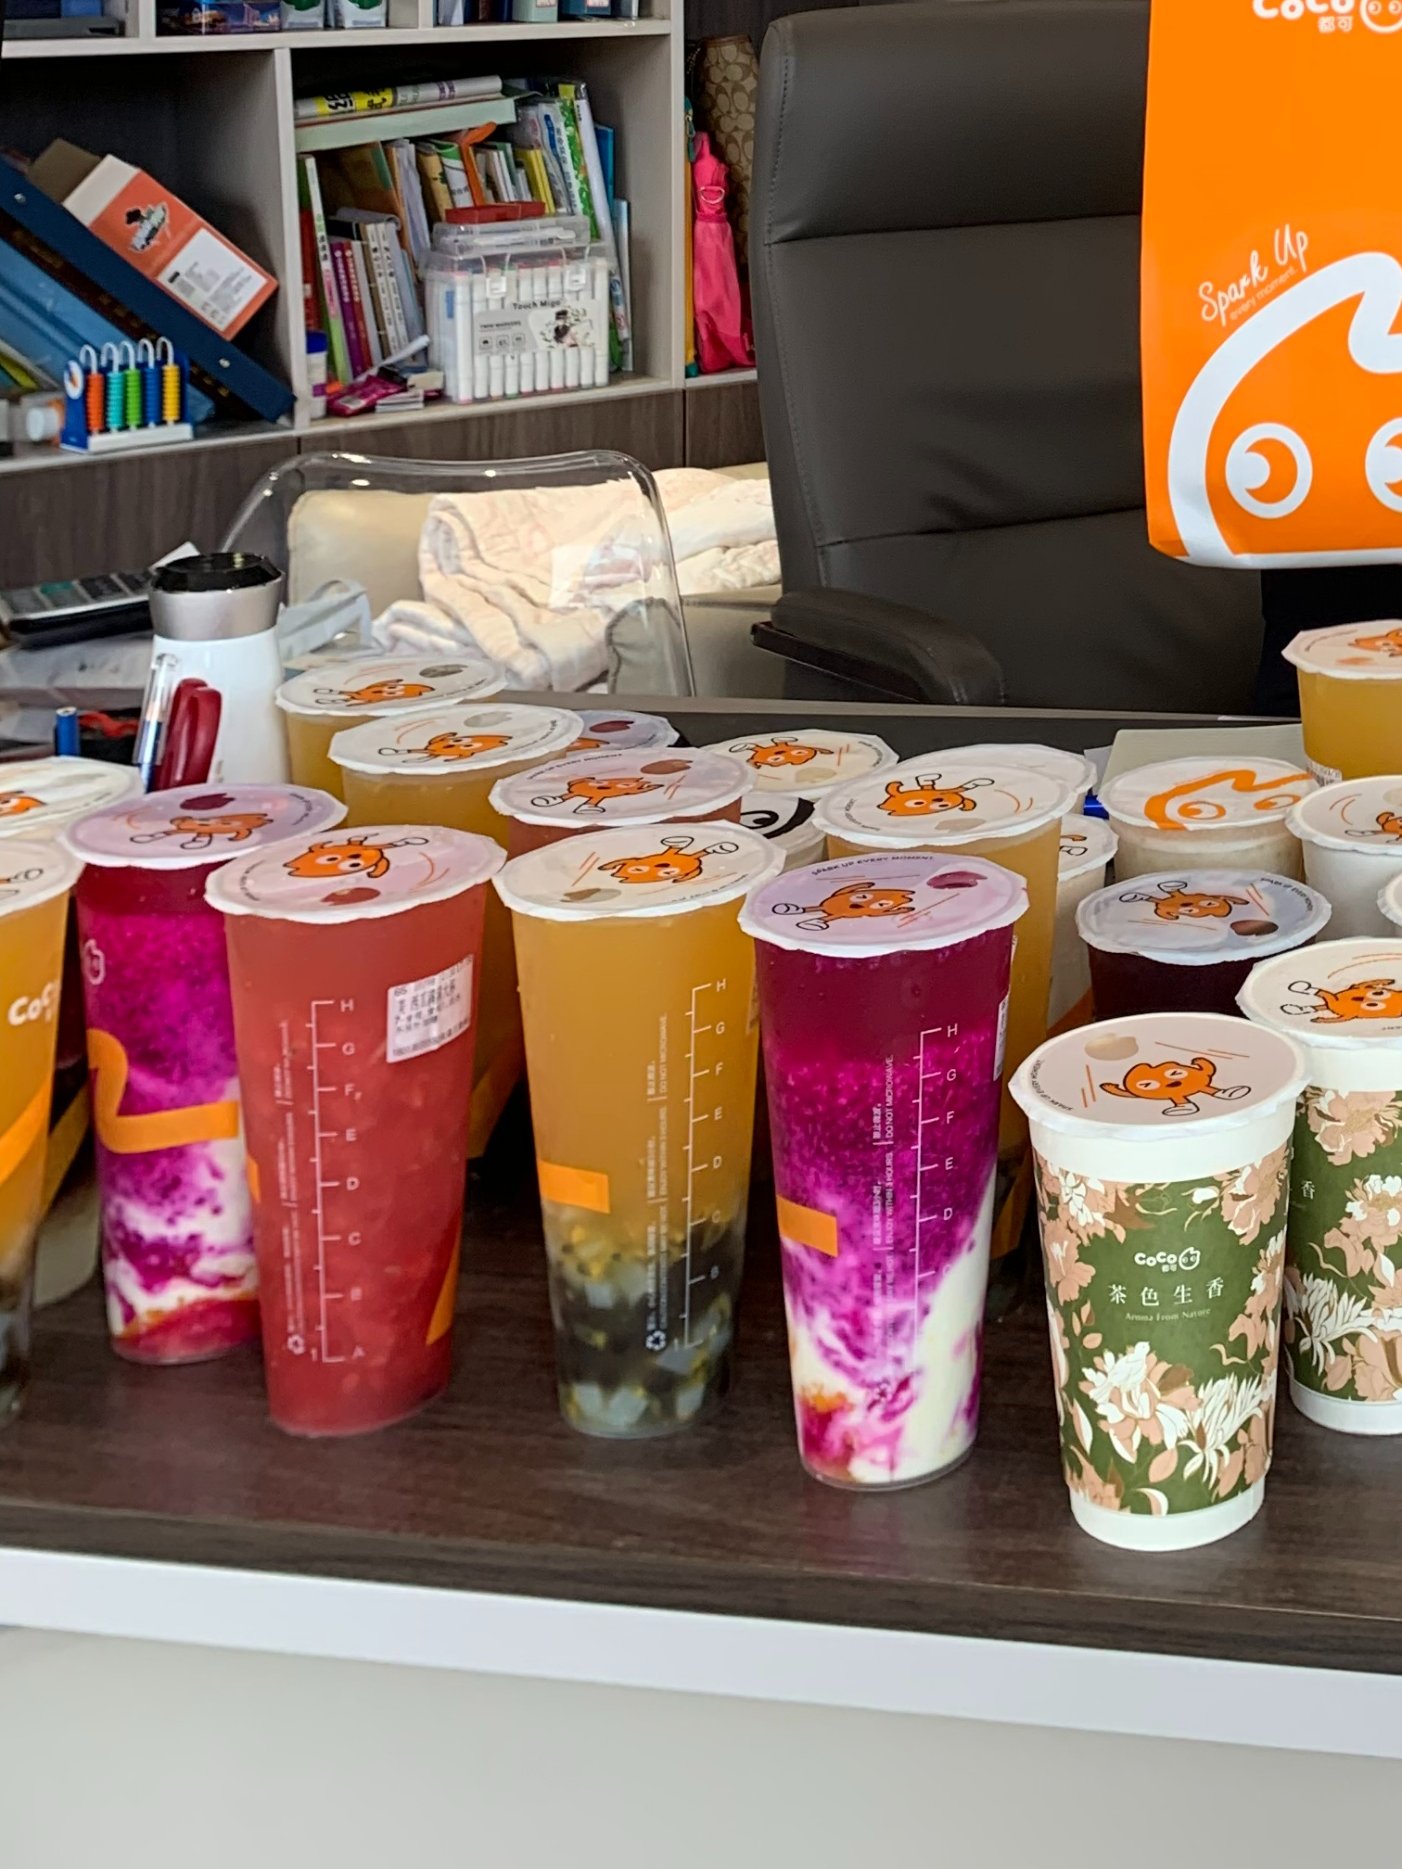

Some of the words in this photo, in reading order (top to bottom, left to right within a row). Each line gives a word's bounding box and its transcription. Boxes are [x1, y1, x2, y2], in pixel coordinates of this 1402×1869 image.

[1317, 16, 1354, 34] 都可
[1198, 249, 1269, 328] Spark
[1274, 223, 1309, 273] Up
[716, 979, 727, 993] H
[340, 999, 354, 1012] H
[715, 1021, 726, 1035] G
[946, 1023, 958, 1037] H
[342, 1043, 356, 1056] G
[946, 1068, 957, 1082] G
[885, 1108, 895, 1125] NOT
[946, 1110, 955, 1124] F
[944, 1157, 954, 1171] E
[346, 1176, 360, 1191] D
[943, 1206, 953, 1221] D
[348, 1232, 362, 1246] C
[1134, 1251, 1178, 1267] CoCo
[1108, 1276, 1225, 1306] 茶色生香
